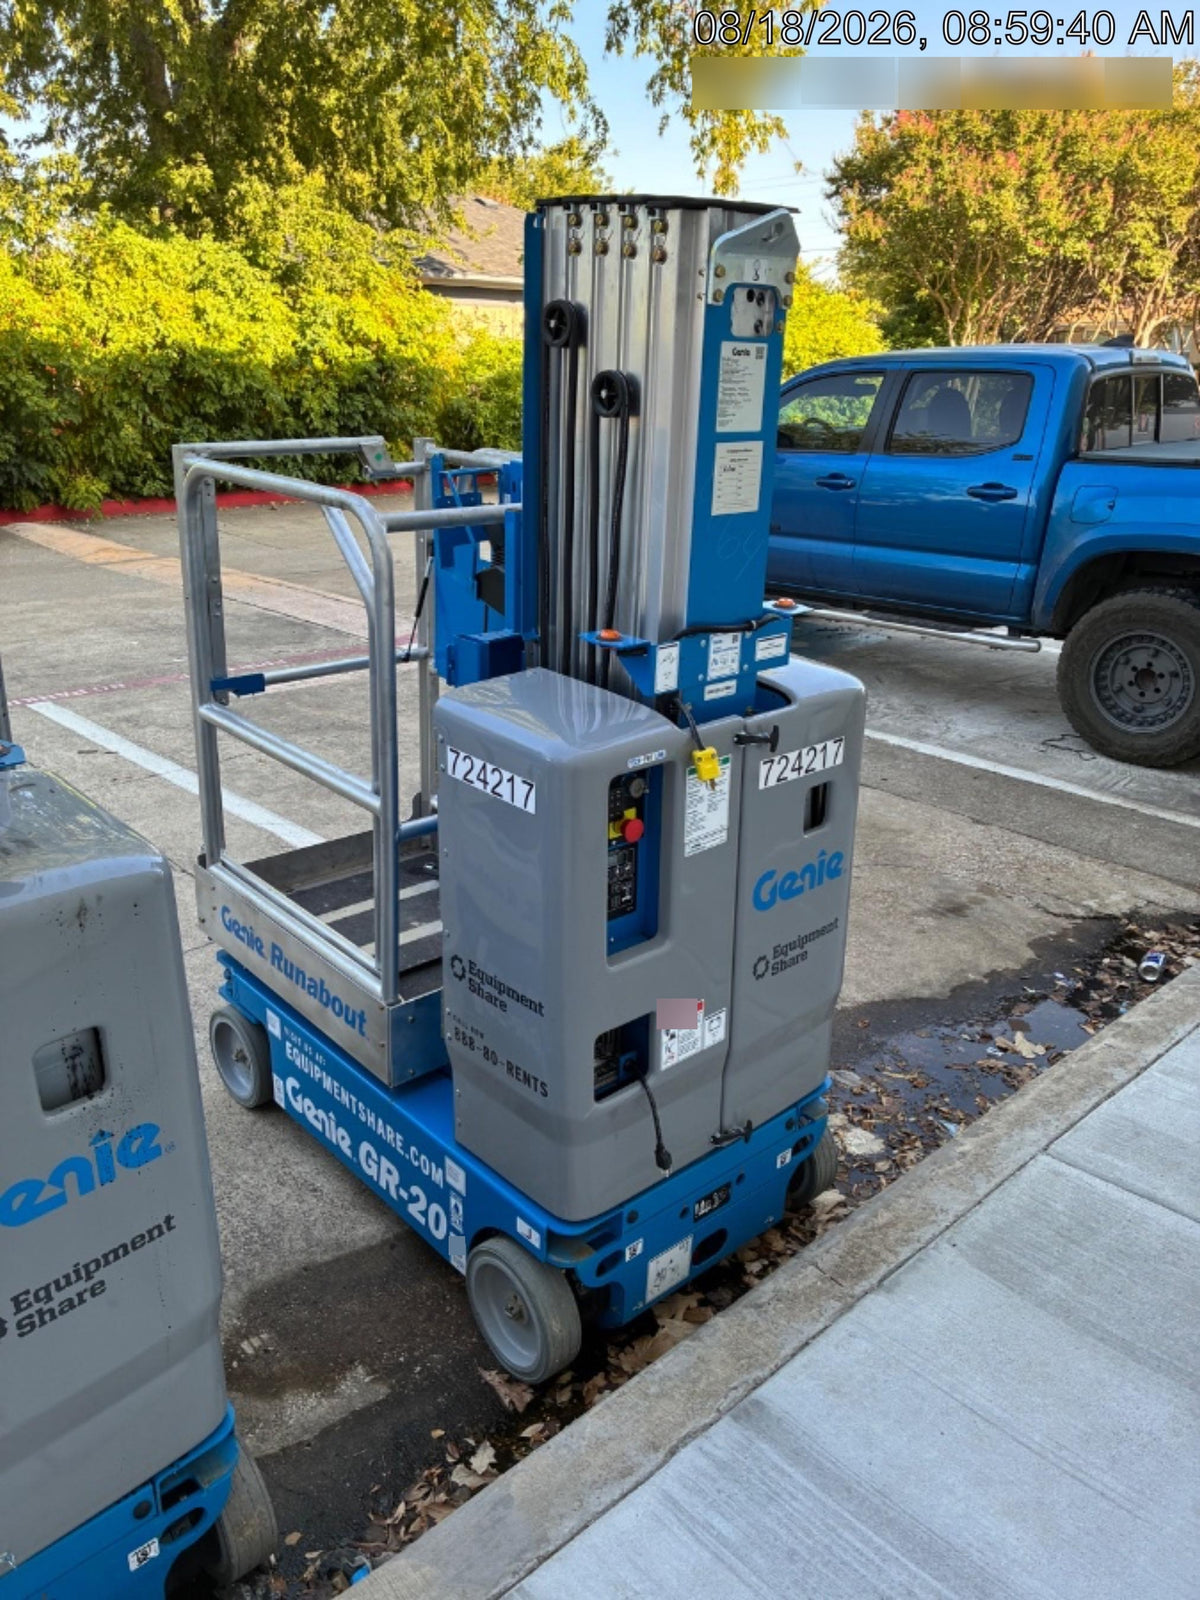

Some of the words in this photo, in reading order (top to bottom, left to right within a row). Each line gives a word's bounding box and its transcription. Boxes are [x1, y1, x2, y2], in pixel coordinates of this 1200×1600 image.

[449, 747, 535, 810] 724217
[762, 738, 844, 787] 724217
[753, 849, 845, 912] Genie
[771, 948, 808, 977] Share
[772, 917, 840, 960] Equipment
[220, 904, 267, 960] Genie
[270, 941, 368, 1037] Runabout
[468, 959, 545, 1018] Equipment
[468, 977, 508, 1013] Share
[285, 1040, 444, 1188] EQUIPMENTSHARE.COM
[0, 1122, 162, 1228] enie
[285, 1076, 353, 1159] Genie
[359, 1141, 447, 1240] GR-20
[10, 1213, 176, 1316] Equipment
[15, 1279, 107, 1338] Share
